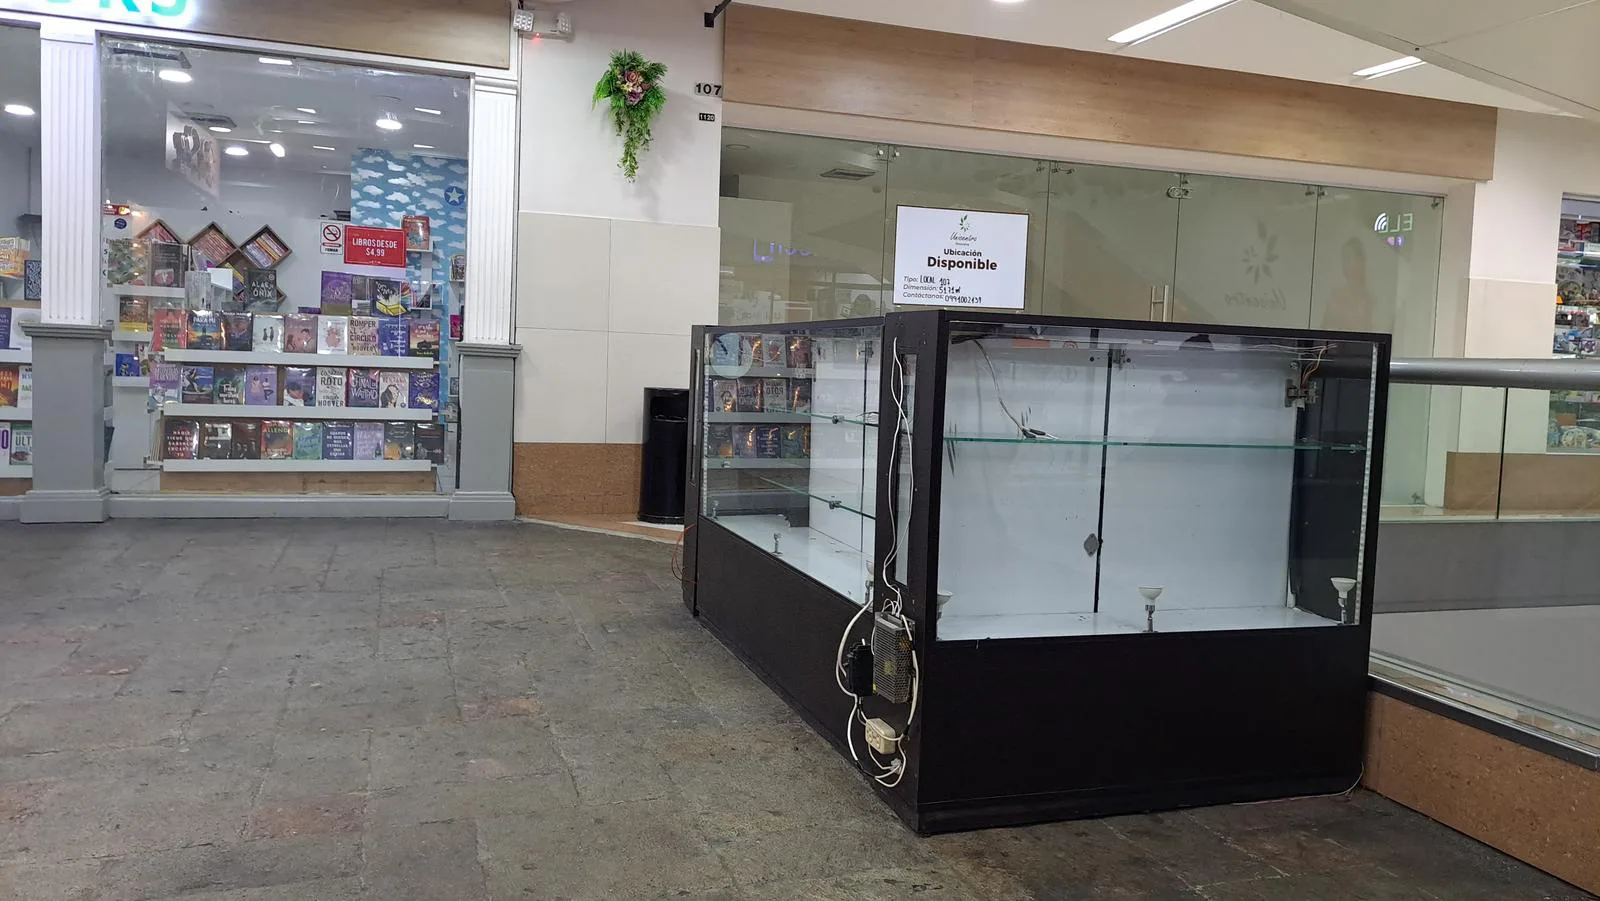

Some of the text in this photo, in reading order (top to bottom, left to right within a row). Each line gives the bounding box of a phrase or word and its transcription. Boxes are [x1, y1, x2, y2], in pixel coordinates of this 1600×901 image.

[696, 83, 722, 95] 107
[352, 237, 376, 248] LIBROS
[376, 239, 398, 249] DESDE
[943, 248, 982, 257] Ubicación
[927, 256, 998, 270] Disponible
[349, 319, 376, 328] ROMPER
[320, 377, 343, 386] ROTO
